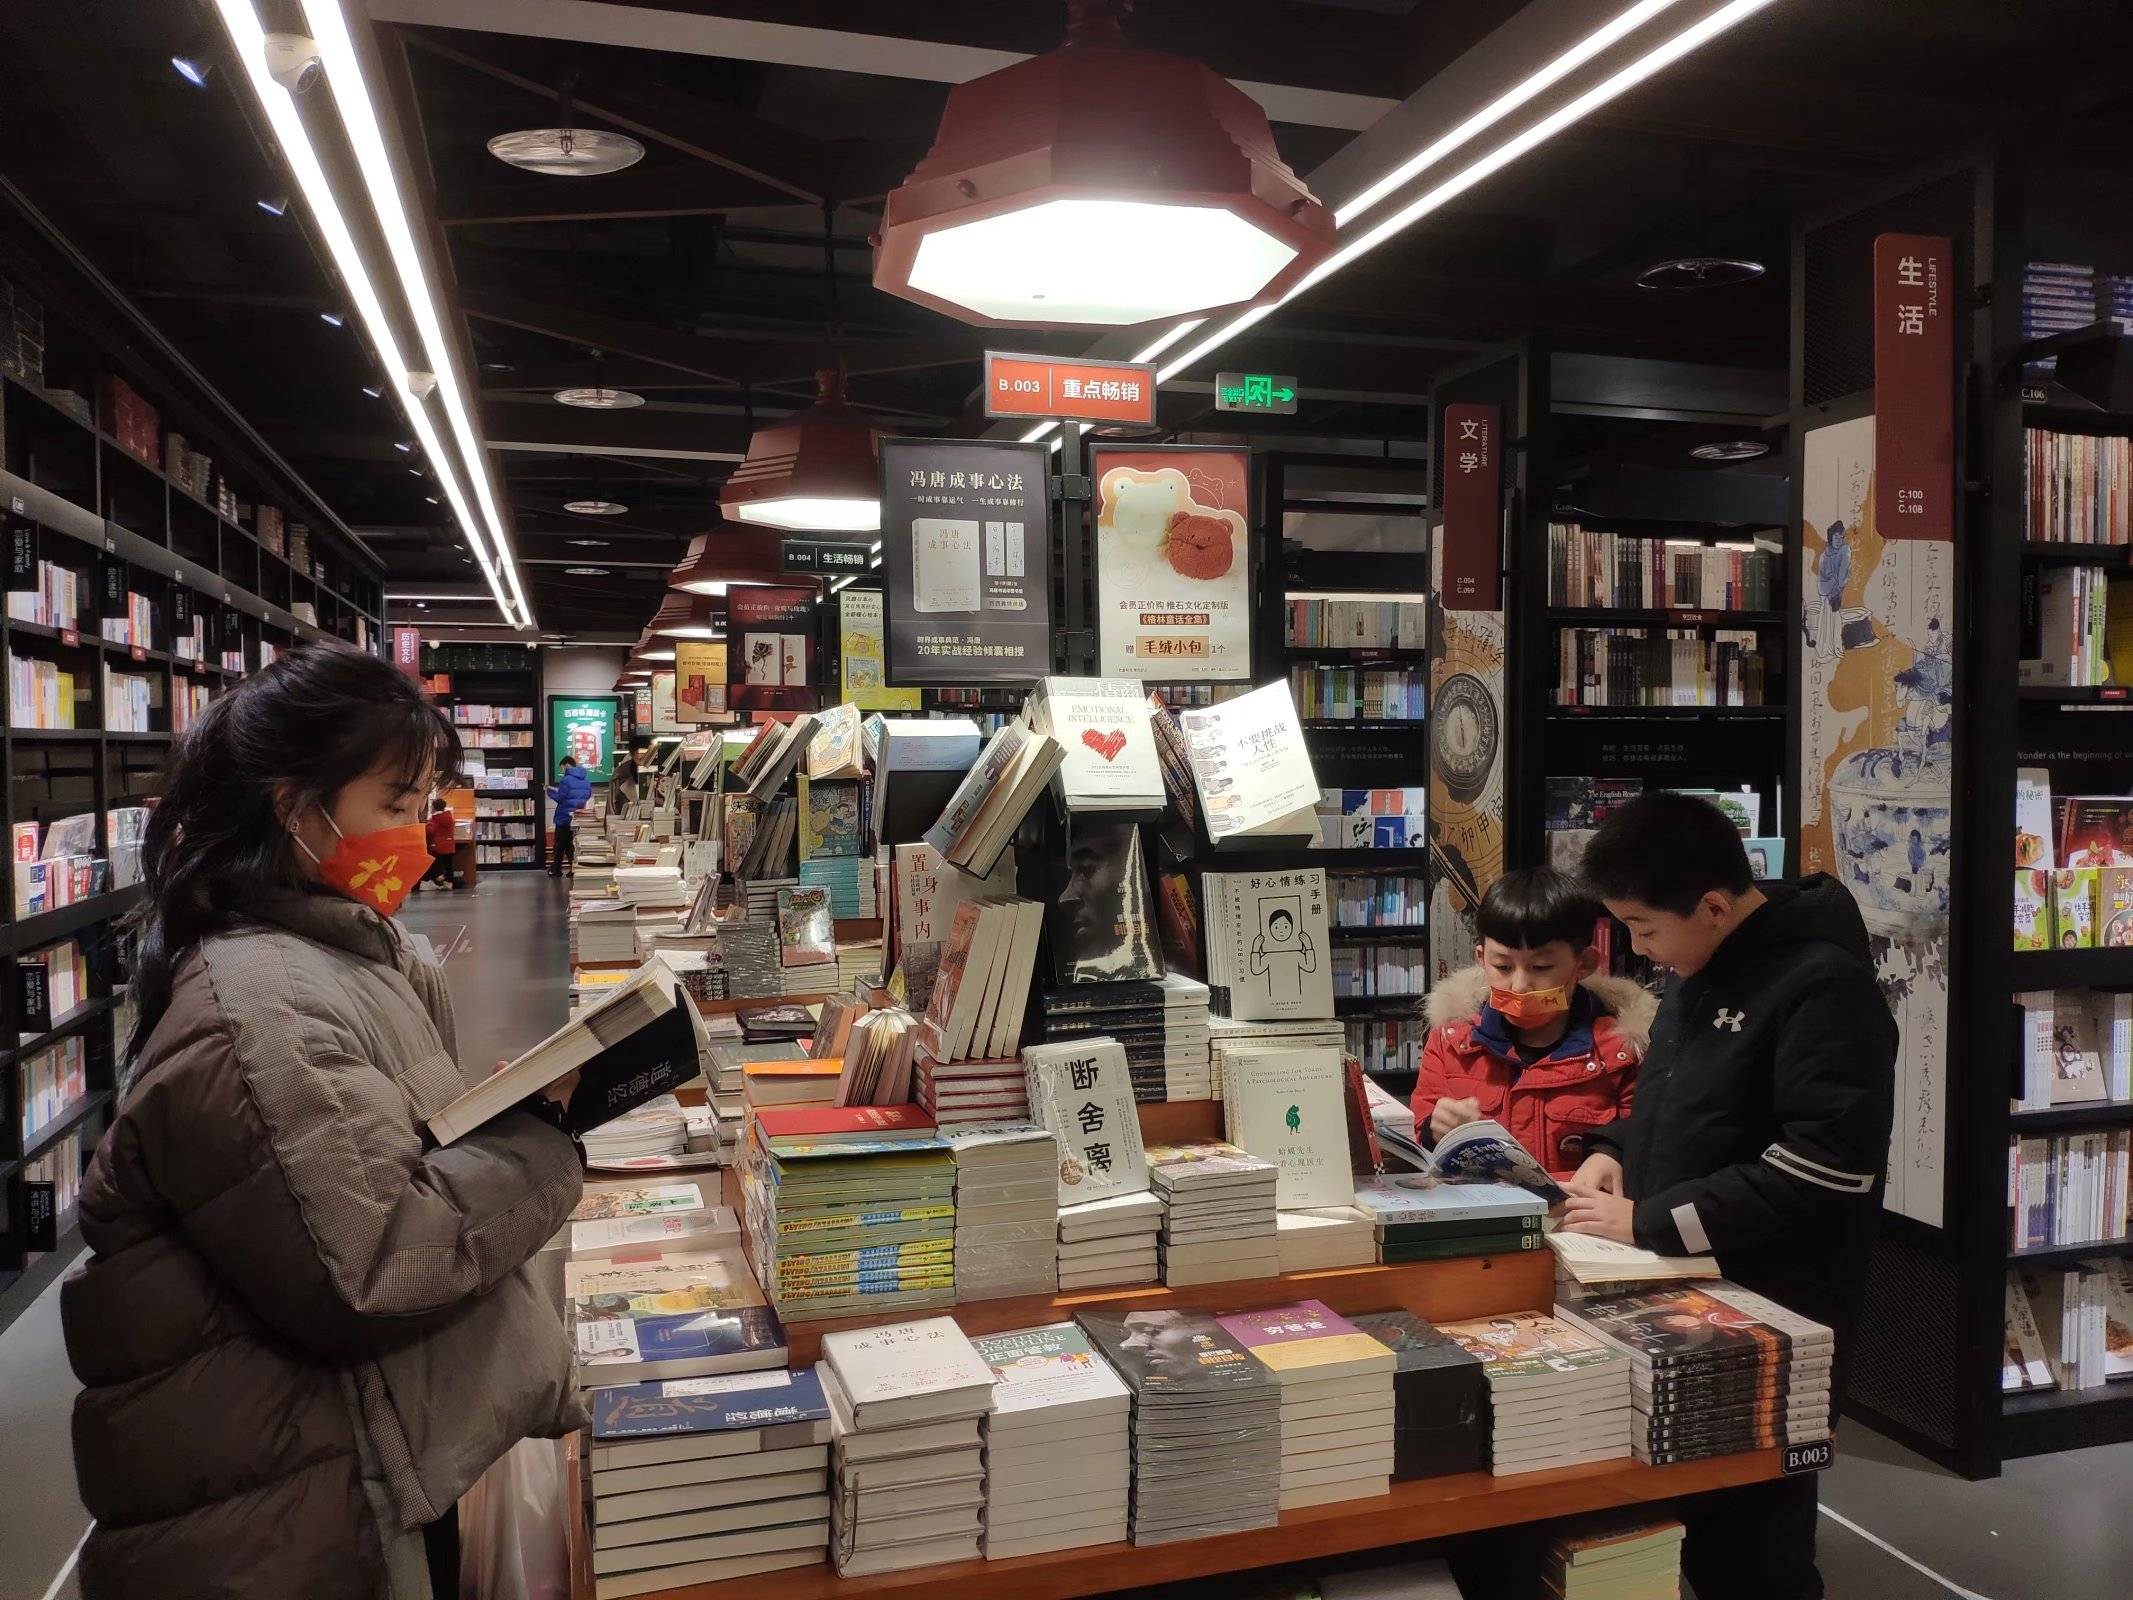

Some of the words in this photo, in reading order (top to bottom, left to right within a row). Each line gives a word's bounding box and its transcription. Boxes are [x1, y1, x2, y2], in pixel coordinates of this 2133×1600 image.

[1928, 257, 1937, 317] LIFESTYLE
[1898, 256, 1924, 335] 生活
[999, 379, 1041, 393] B.003
[1062, 379, 1140, 402] 重点畅销
[2021, 388, 2045, 400] C.106
[1459, 419, 1479, 474] 文学
[910, 470, 1023, 491] 冯唐成事心法
[1898, 489, 1923, 500] C.100
[1898, 504, 1923, 514] C.108
[788, 553, 811, 562] B.004
[822, 553, 864, 565] 生活畅销
[1119, 600, 1164, 610] 会员正价购
[917, 646, 1025, 657] 20年实战经验倾囊相授
[1144, 640, 1202, 654] 毛绒小包
[1211, 645, 1226, 654] 1个
[1071, 704, 1128, 715] EMOTIONAL
[1067, 713, 1136, 724] INTELLIGENCE
[2057, 751, 2071, 760] the
[1250, 874, 1320, 889] 好心情练习
[911, 854, 938, 941] 置身事内
[1309, 888, 1322, 916] 手册
[1070, 1057, 1112, 1176] 断舍离
[1263, 1321, 1327, 1335] 穷爸爸
[980, 1331, 1052, 1348] POSITIVE
[986, 1343, 1063, 1362] 正面管教
[1788, 1446, 1830, 1468] B.003
